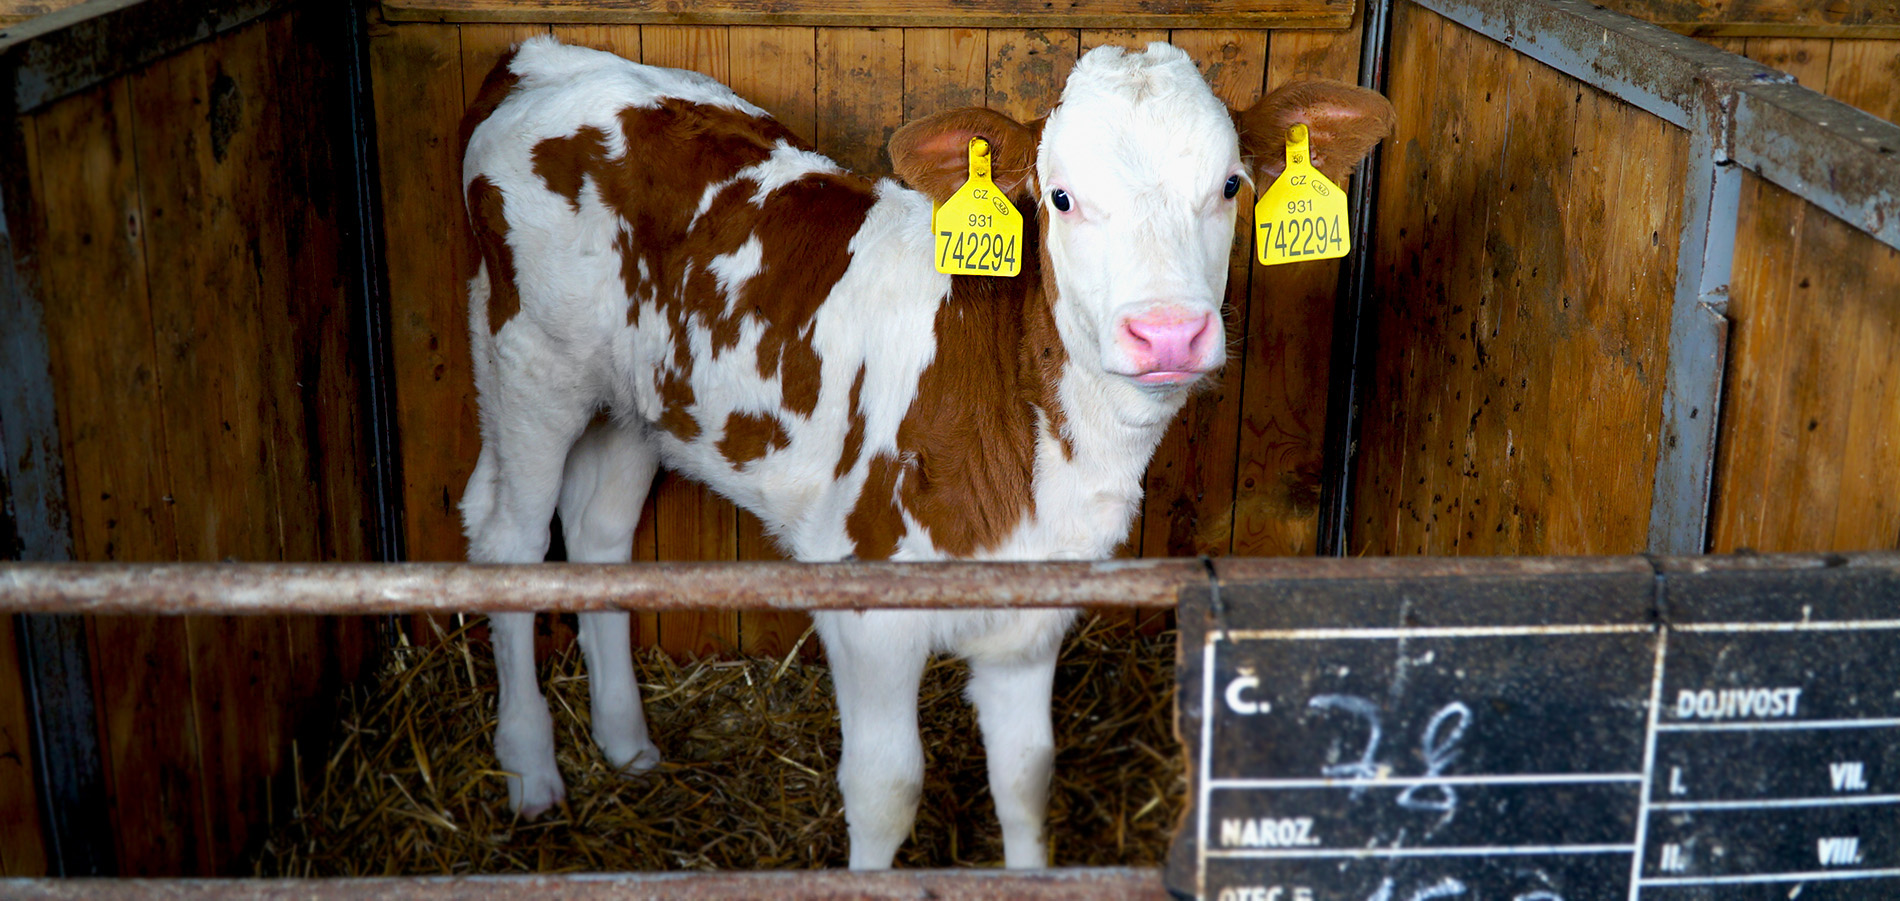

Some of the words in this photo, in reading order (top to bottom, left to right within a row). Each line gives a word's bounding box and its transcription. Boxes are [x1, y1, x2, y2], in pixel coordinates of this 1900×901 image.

[973, 189, 988, 200] CZ
[1290, 175, 1307, 186] CZ
[1287, 199, 1312, 214] 931
[968, 214, 993, 228] 931
[1260, 214, 1342, 259] 742294
[940, 231, 1016, 272] 742294
[1225, 666, 1271, 715] Č.
[1677, 687, 1802, 718] DOJIVOST
[1669, 766, 1688, 794] I.
[1829, 762, 1867, 790] VII.
[1220, 818, 1322, 847] NAROZ.
[1660, 843, 1685, 871] II.
[1817, 837, 1864, 866] VIII.
